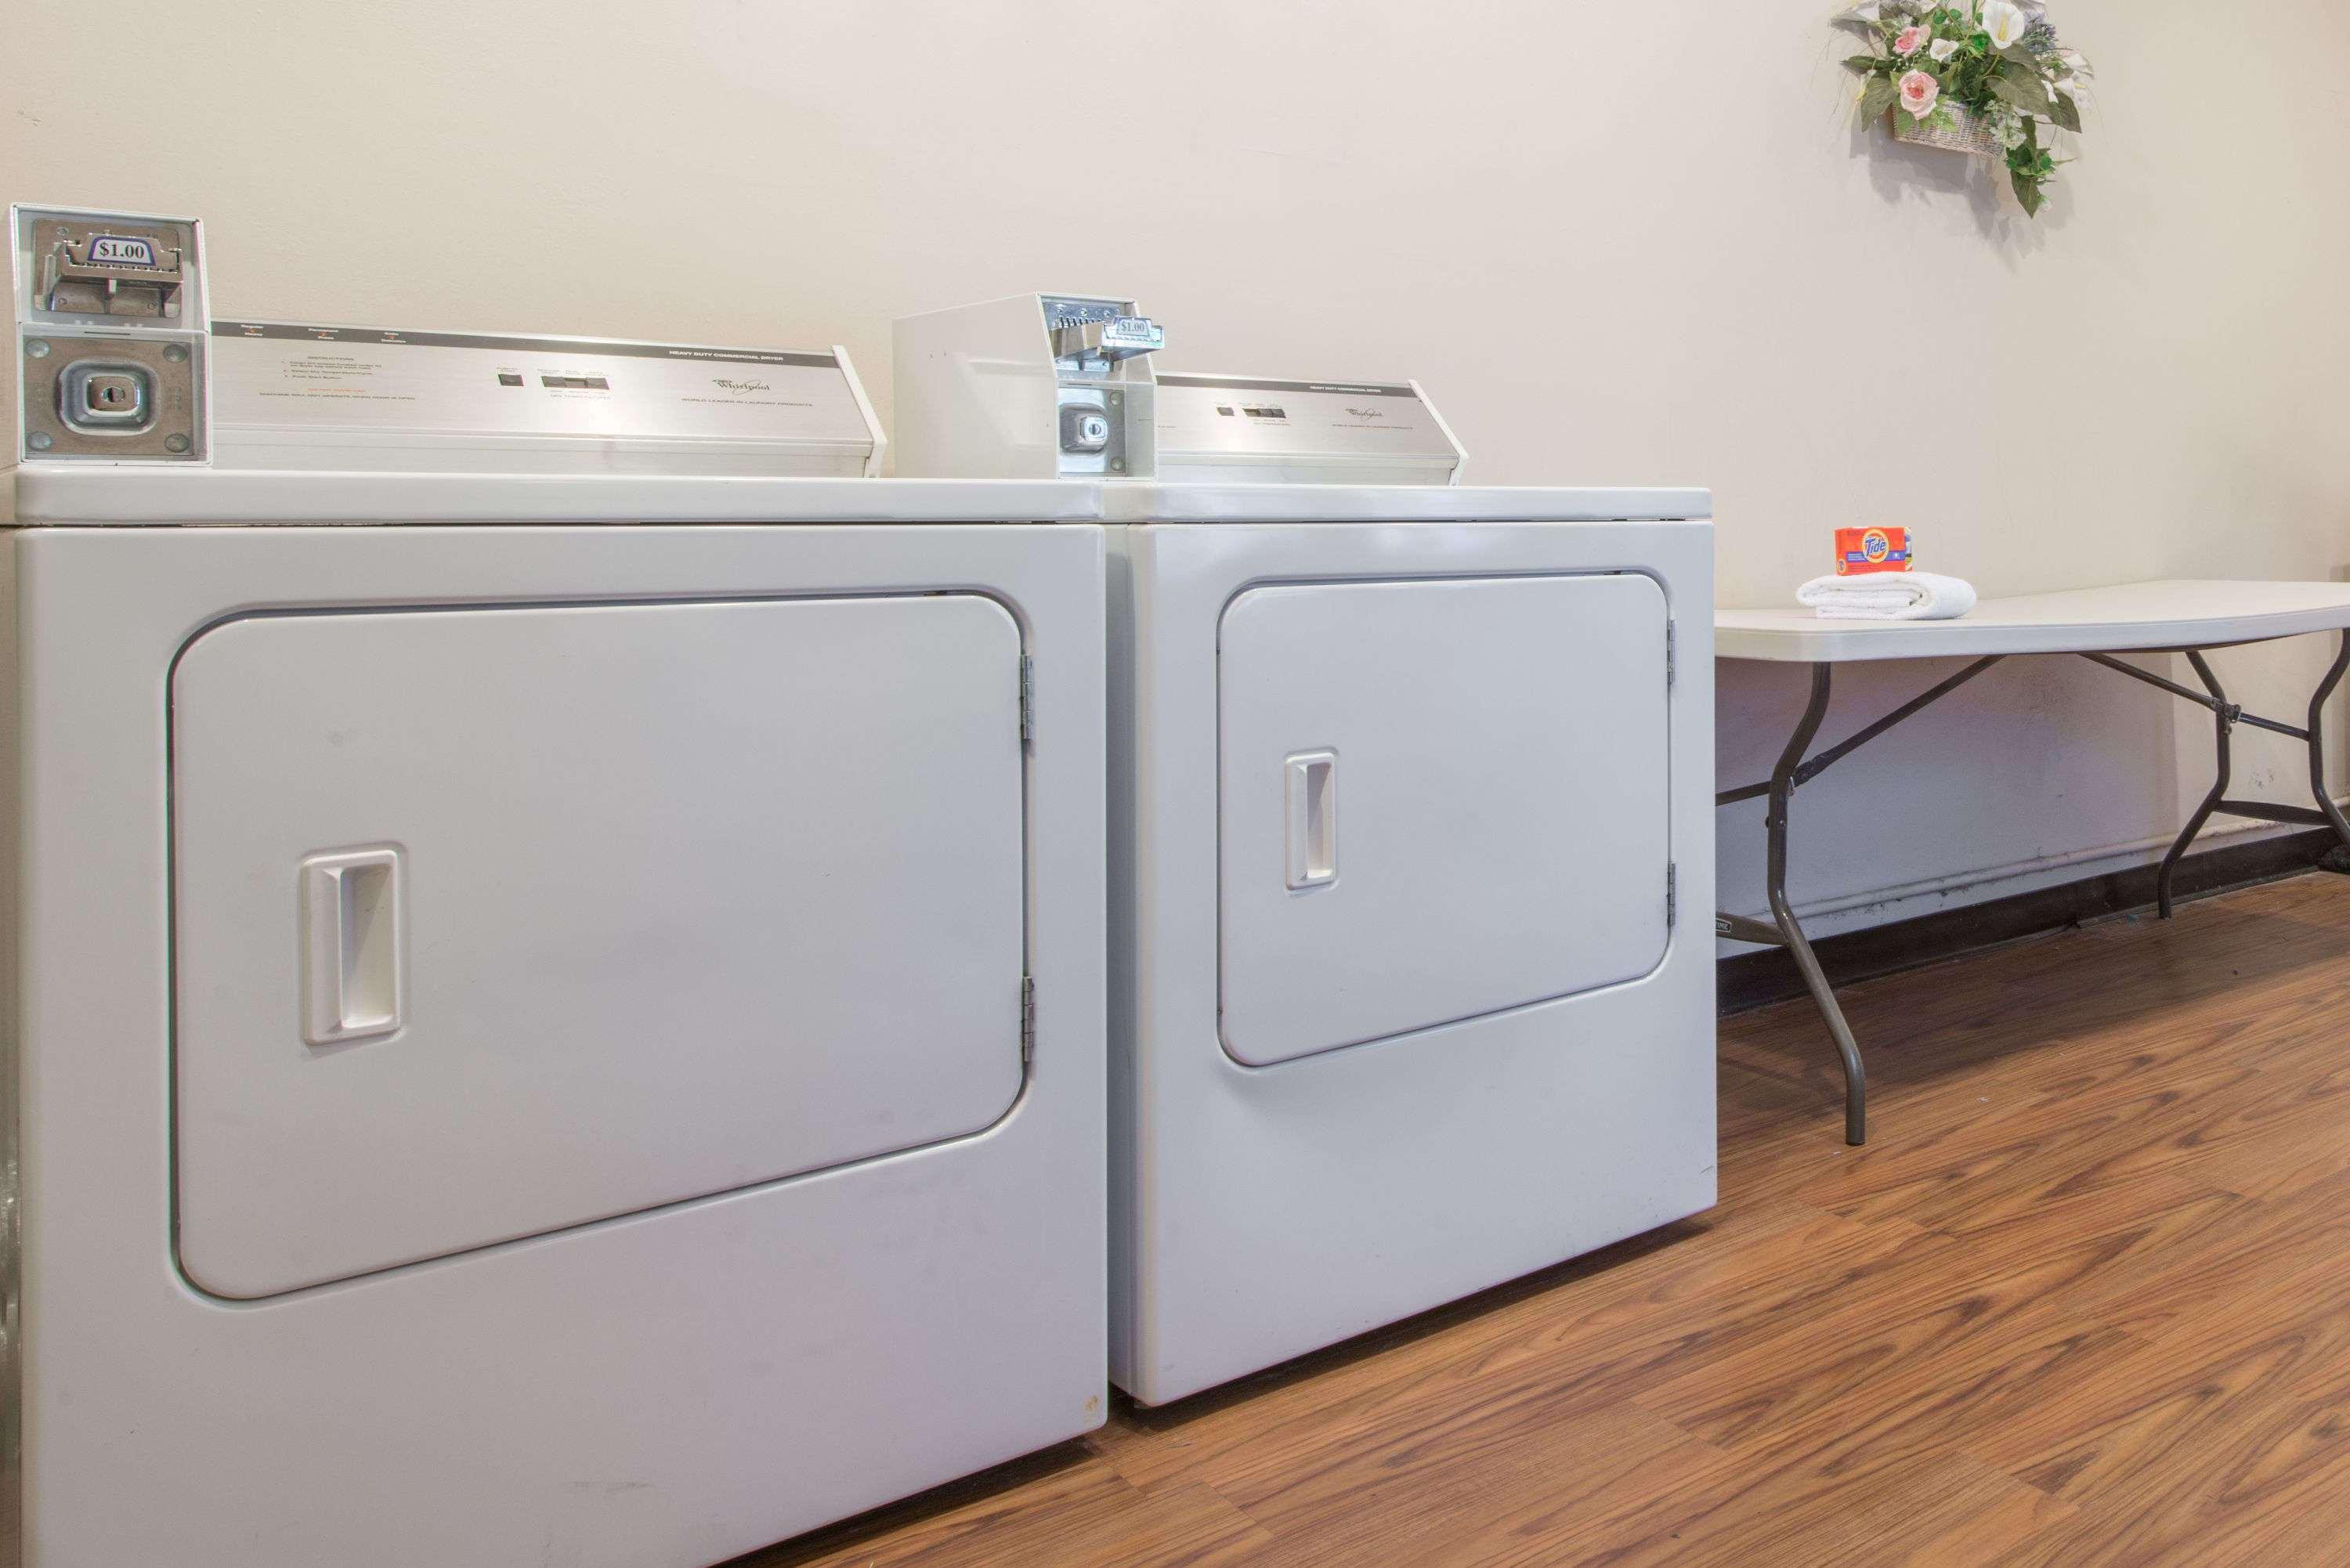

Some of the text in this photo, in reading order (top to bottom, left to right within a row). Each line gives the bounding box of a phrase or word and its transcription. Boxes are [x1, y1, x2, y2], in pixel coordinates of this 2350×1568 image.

[99, 241, 144, 258] $1.00
[1121, 320, 1144, 332] $1.00
[713, 379, 771, 395] Whirlpool
[1865, 537, 1887, 557] Tide
